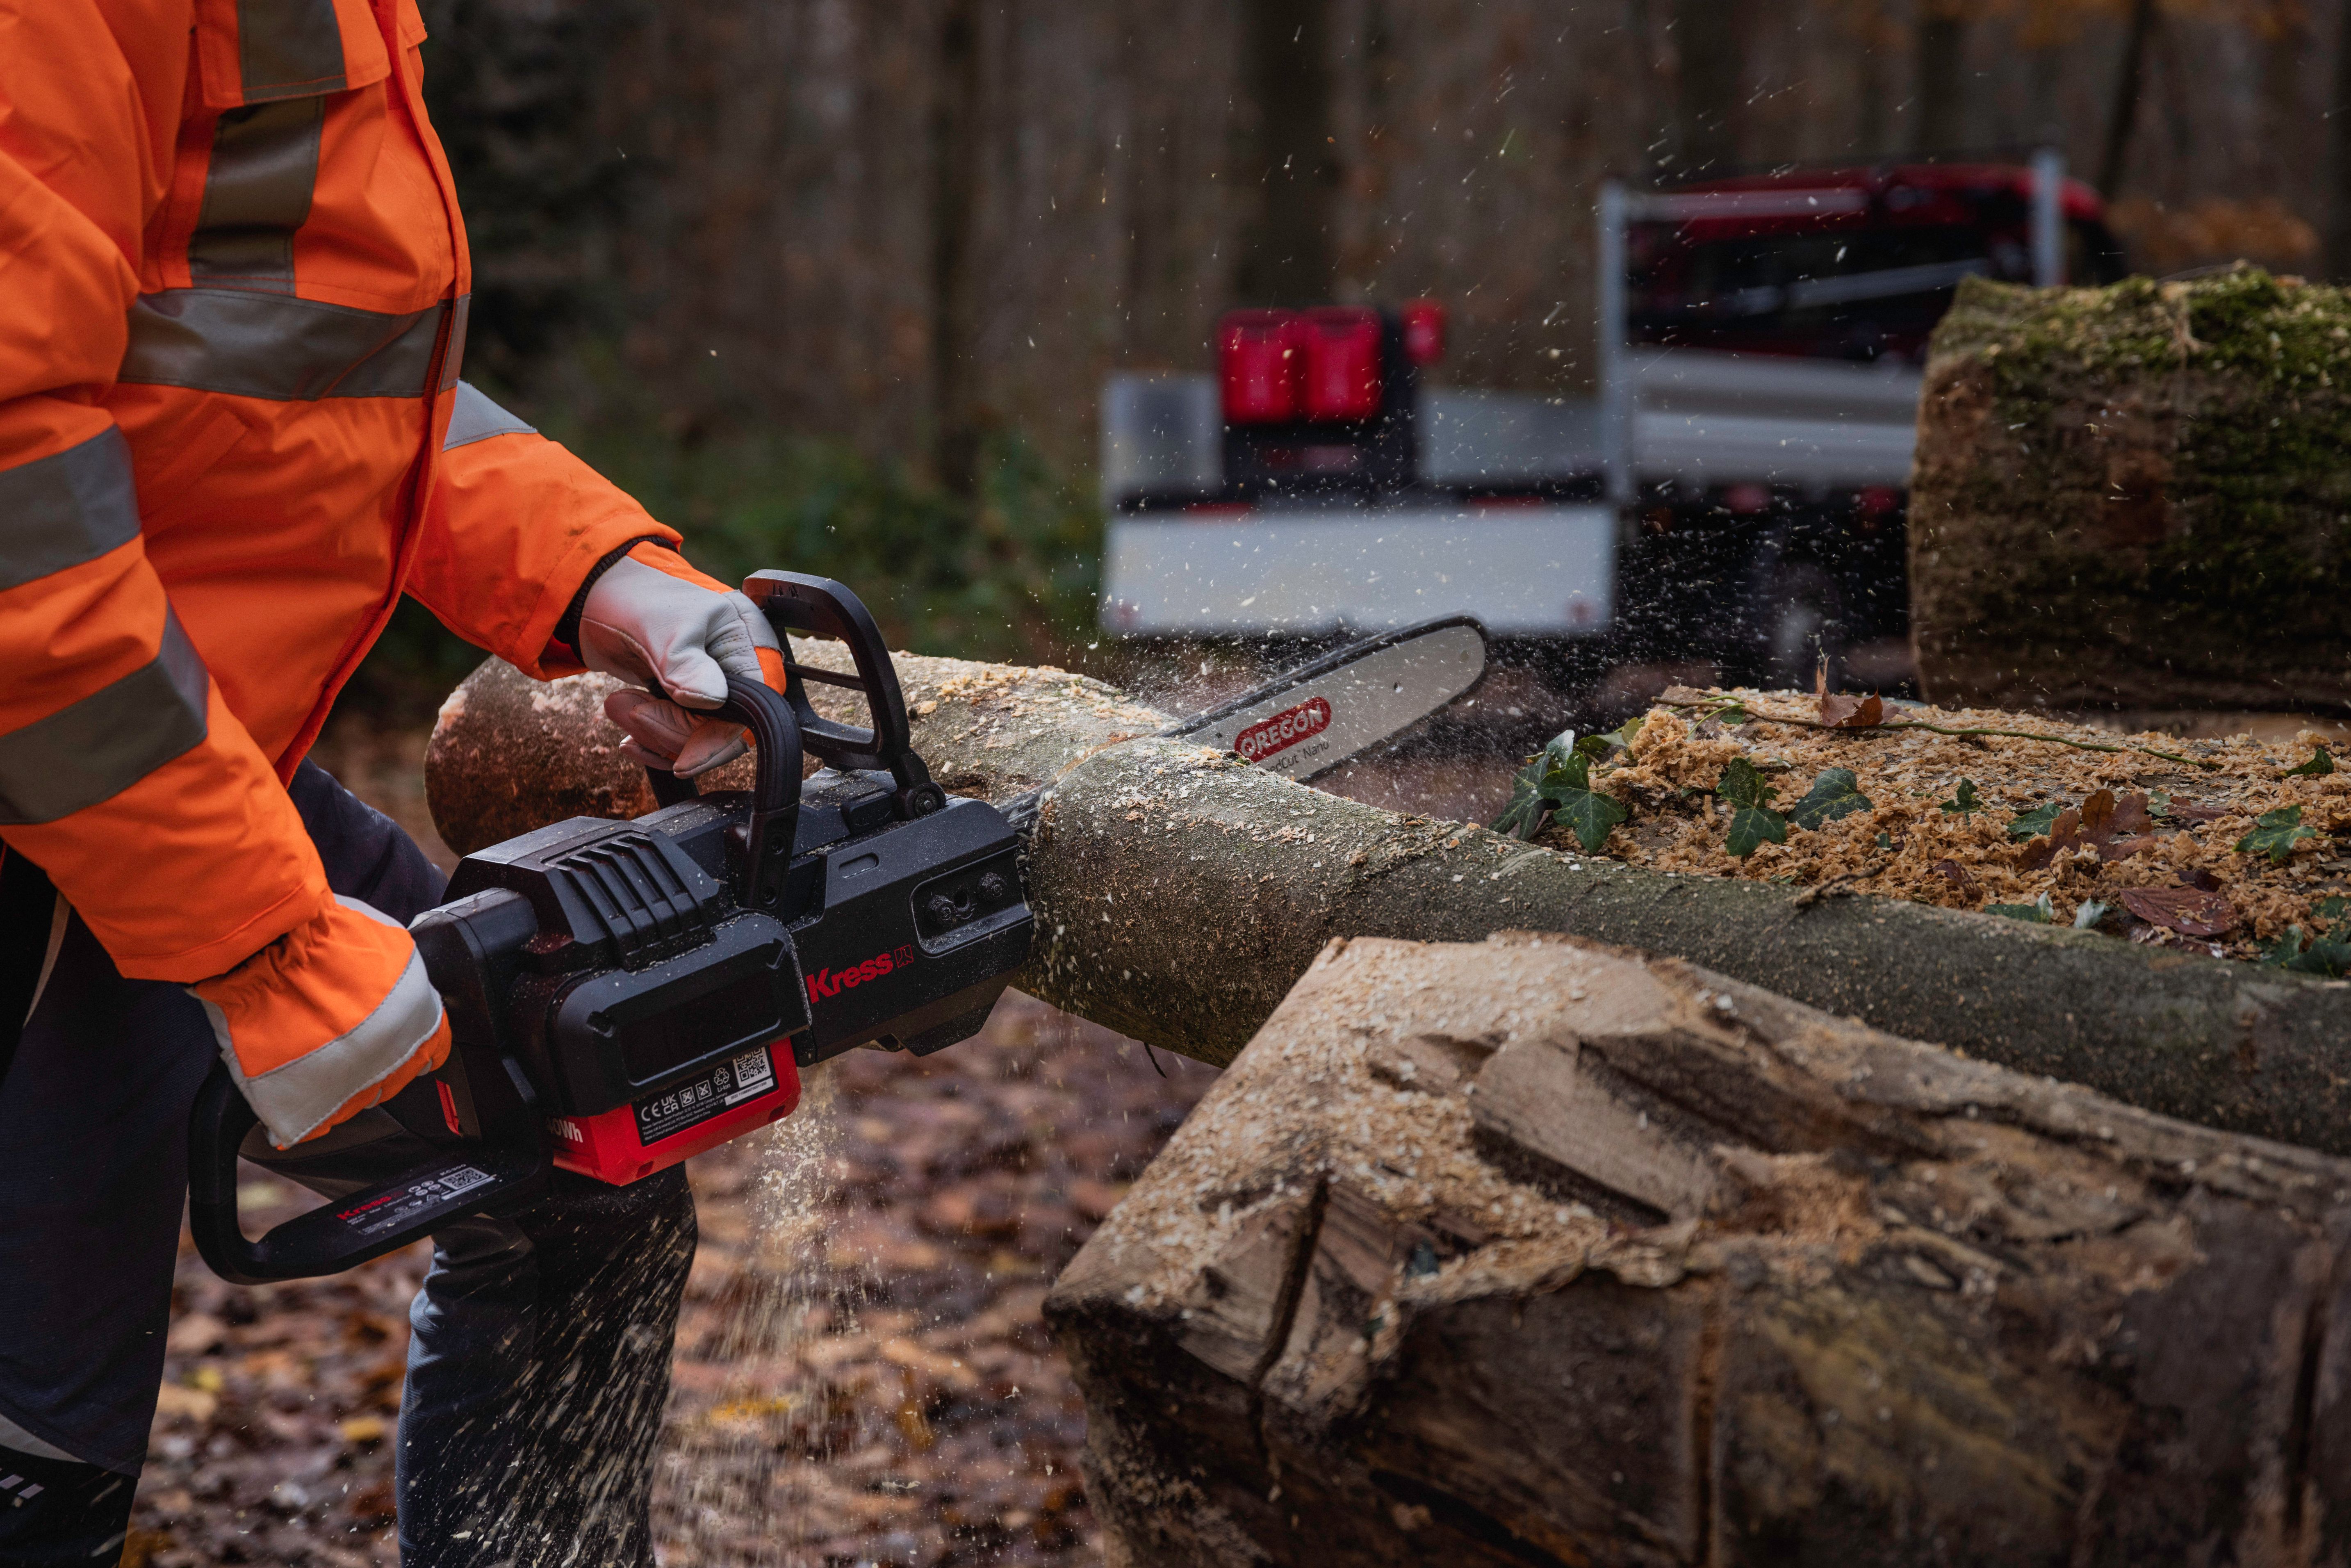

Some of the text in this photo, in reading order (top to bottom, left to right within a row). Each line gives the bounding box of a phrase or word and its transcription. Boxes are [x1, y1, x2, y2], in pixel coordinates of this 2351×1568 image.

[1240, 704, 1324, 757] OREGON
[1303, 742, 1329, 759] Nano
[805, 953, 893, 1004] Kress
[661, 1094, 677, 1106] UK
[663, 1103, 679, 1115] CA
[641, 1102, 661, 1121] CE
